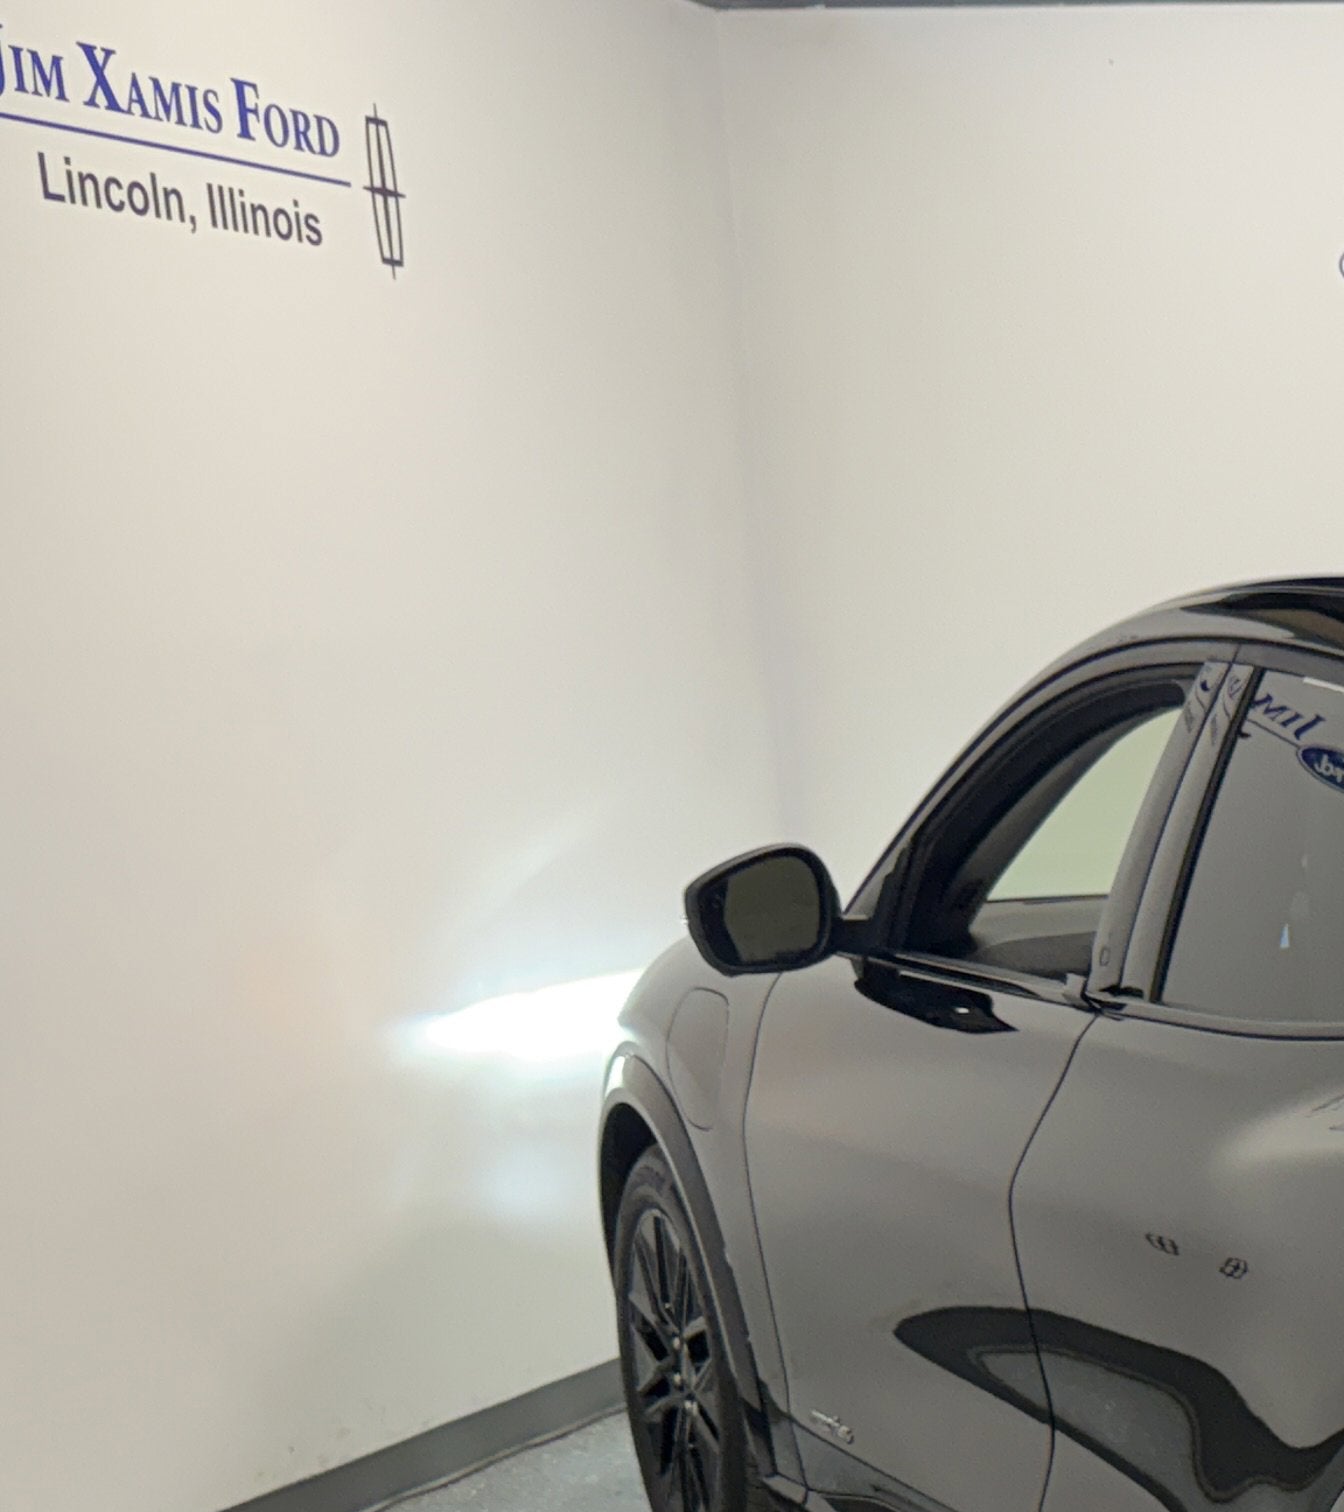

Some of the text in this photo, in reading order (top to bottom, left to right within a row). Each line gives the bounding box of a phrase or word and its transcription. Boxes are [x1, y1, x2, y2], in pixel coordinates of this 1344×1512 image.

[75, 41, 223, 134] XAMIS
[230, 77, 340, 158] FORD
[37, 151, 323, 247] Lincoln, Illinois
